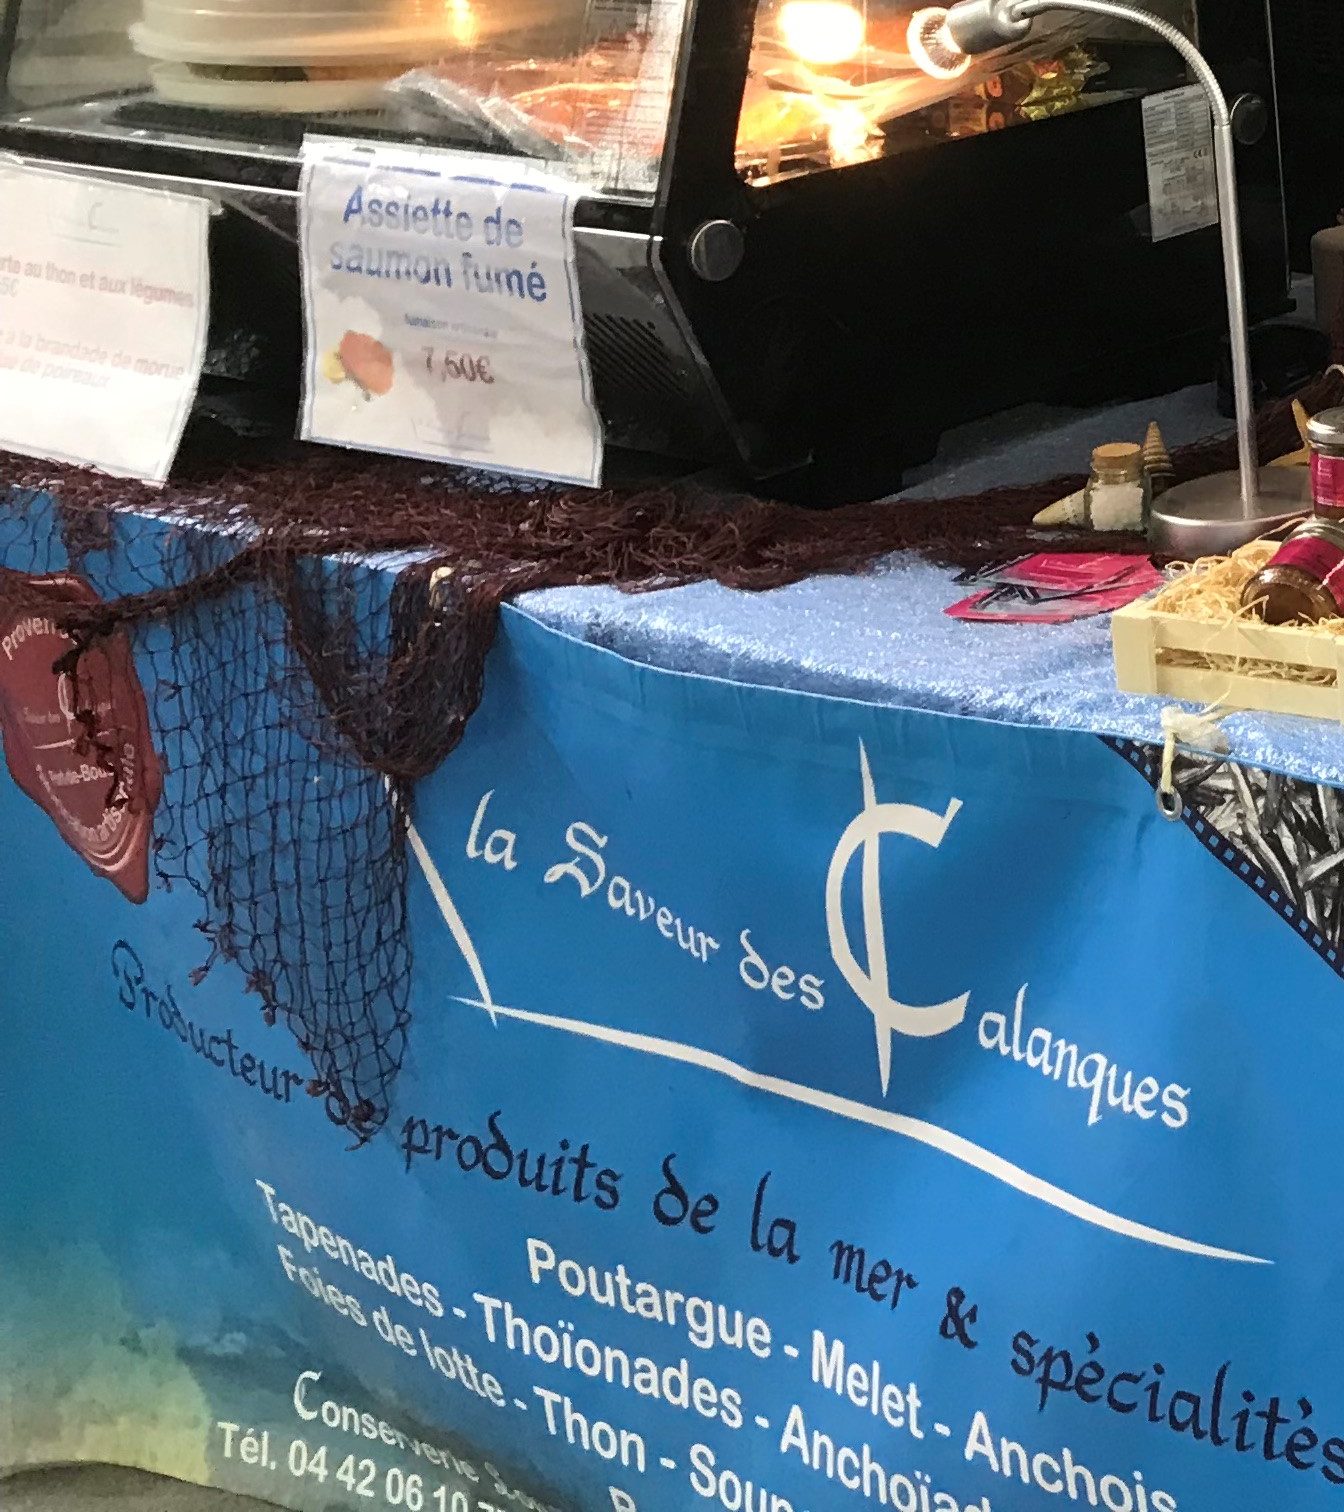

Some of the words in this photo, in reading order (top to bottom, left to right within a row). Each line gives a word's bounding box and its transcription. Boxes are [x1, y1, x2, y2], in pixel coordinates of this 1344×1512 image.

[330, 240, 454, 289] saumon
[462, 251, 548, 302] fumé
[342, 185, 473, 241] Assiette
[484, 207, 524, 248] de
[466, 788, 518, 871] la
[543, 821, 720, 964] Saveur
[739, 928, 827, 1010] des
[826, 736, 1190, 1128] Calanques
[110, 938, 303, 1103] Producteur
[401, 1109, 623, 1211] produits
[653, 1152, 720, 1235] de
[750, 1171, 801, 1264] la
[829, 1239, 919, 1310] mer
[939, 1286, 978, 1349] &
[255, 1178, 444, 1318] Tapenades
[473, 1292, 744, 1429] Thoïonades
[278, 1245, 367, 1328] Foies
[373, 1306, 417, 1357] de
[419, 1327, 506, 1408] lotte
[533, 1385, 646, 1473] Thon
[526, 1237, 772, 1360] Poutargue
[811, 1329, 923, 1439] Melet
[964, 1411, 1178, 1512] Anchois
[216, 1421, 276, 1470] Tél.
[288, 1439, 328, 1483] 04
[335, 1455, 376, 1498] 42
[385, 1468, 424, 1512] 06
[293, 1370, 480, 1483] Conserverie
